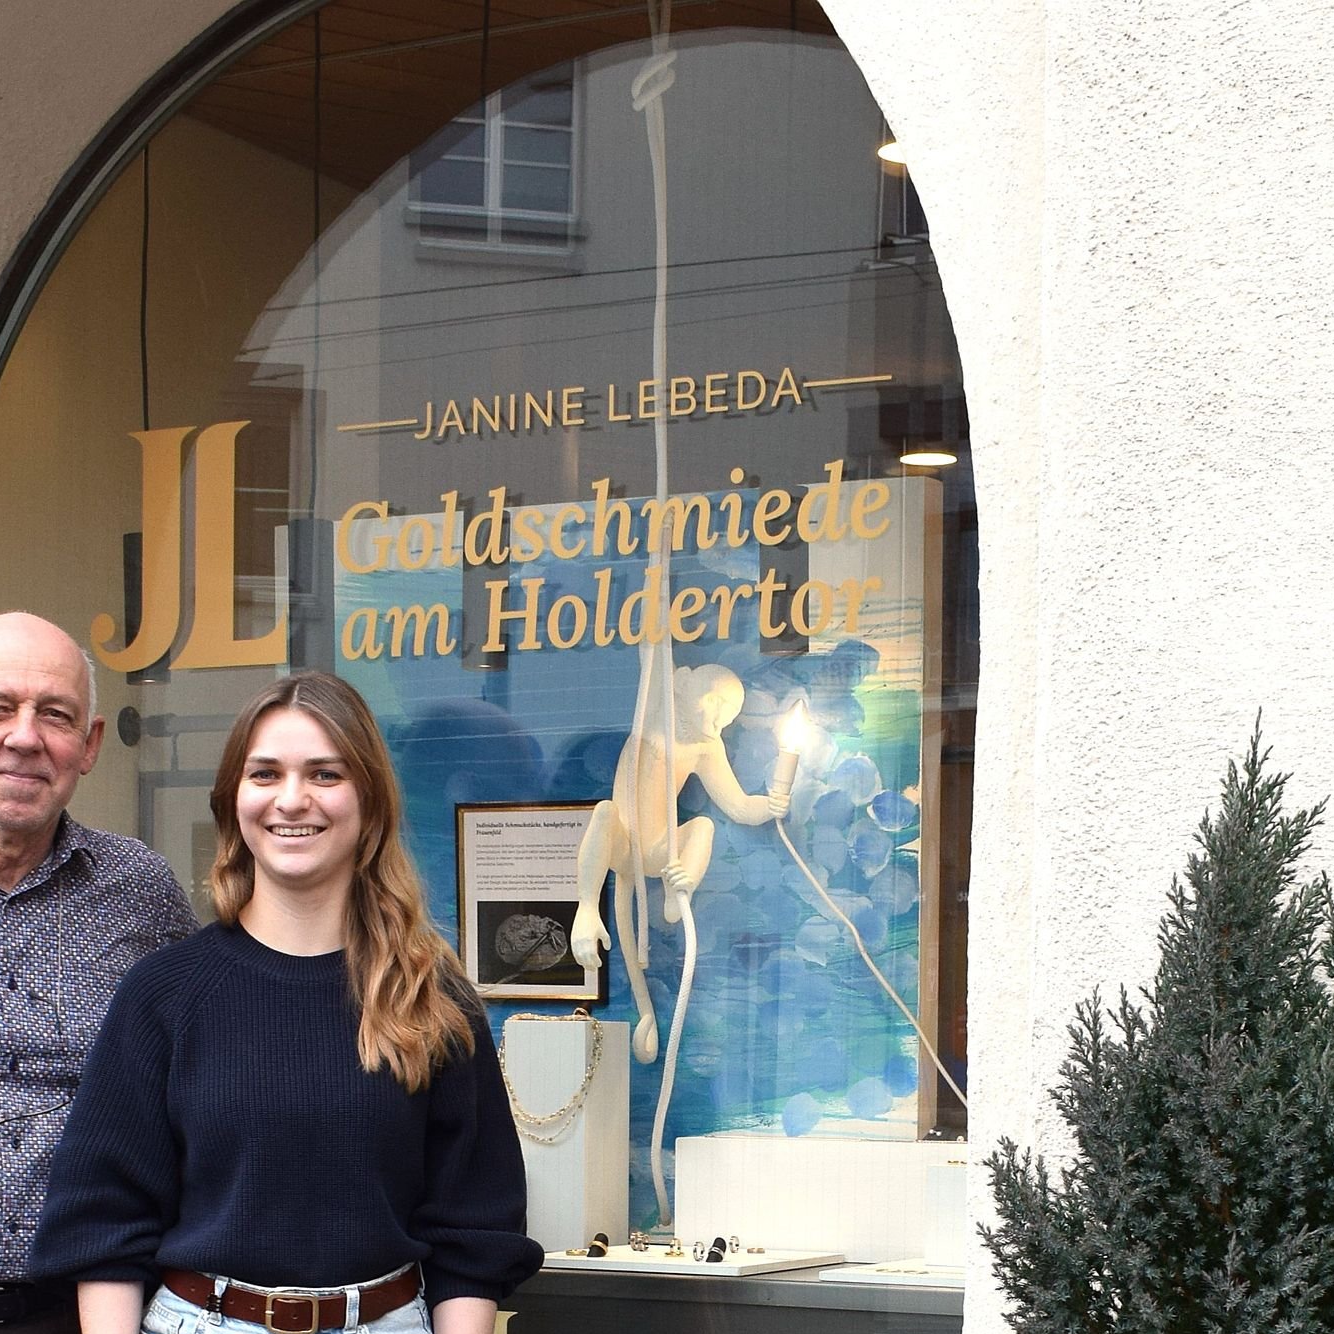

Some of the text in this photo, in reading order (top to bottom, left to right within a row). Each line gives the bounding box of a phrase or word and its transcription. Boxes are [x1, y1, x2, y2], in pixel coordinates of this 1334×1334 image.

[413, 366, 804, 441] JANINE LEBEDA
[91, 419, 288, 672] JL
[336, 459, 892, 575] Goldschmiede
[340, 566, 885, 661] am Holdertor
